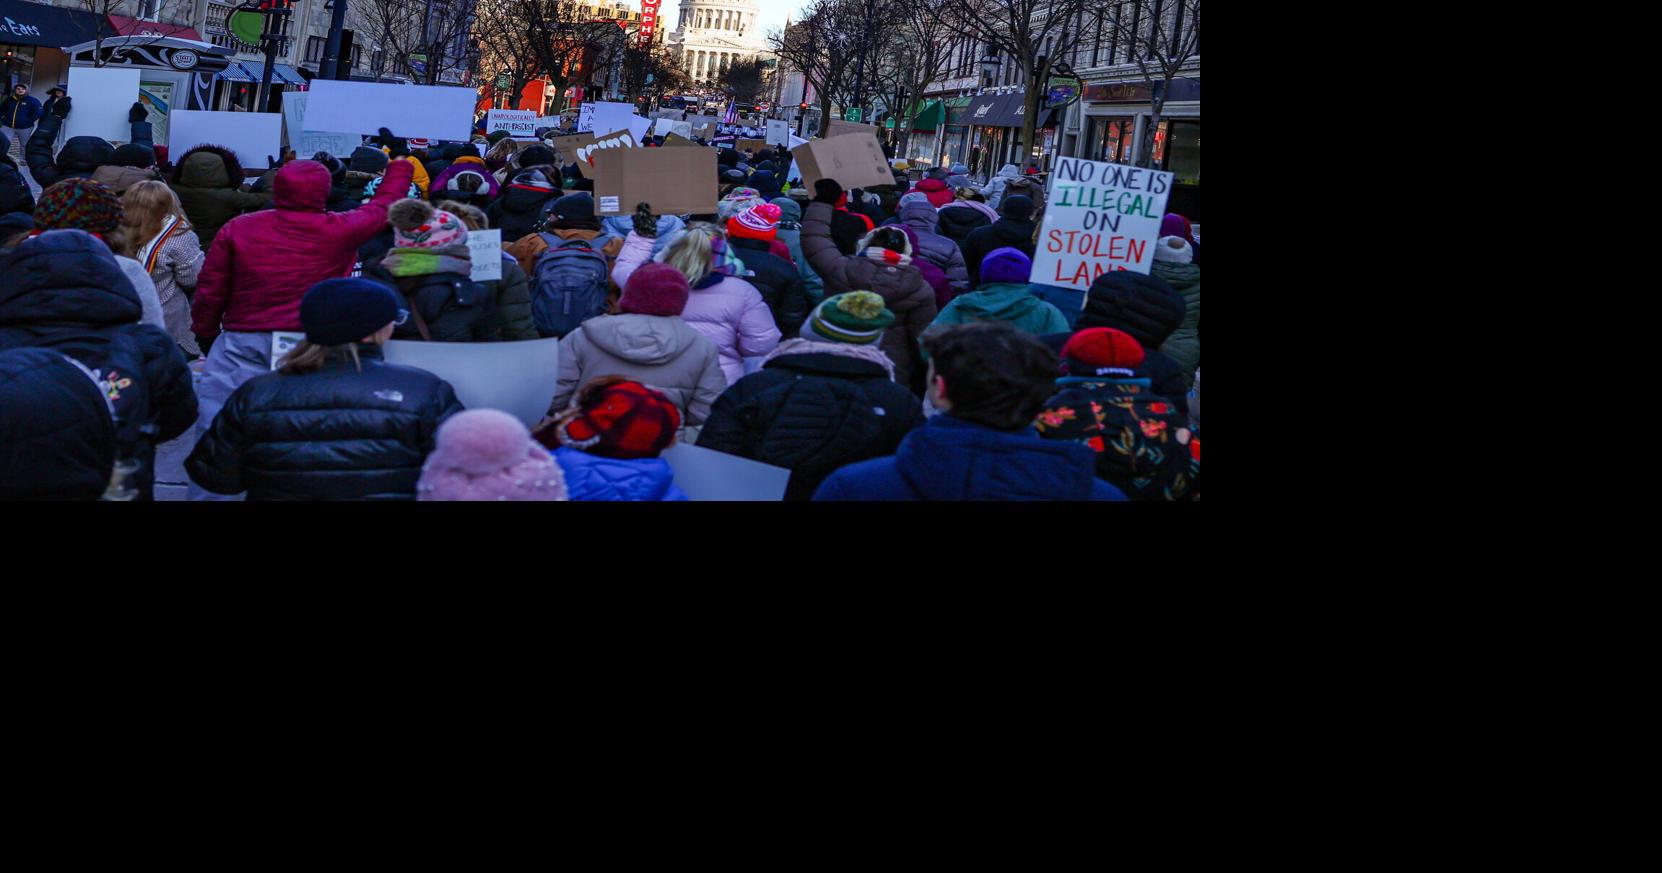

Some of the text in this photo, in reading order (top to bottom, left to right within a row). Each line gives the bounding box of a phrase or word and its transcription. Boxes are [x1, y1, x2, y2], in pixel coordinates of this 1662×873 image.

[4, 16, 40, 36] Eats
[494, 122, 535, 131] ANTI-FASCIST
[1057, 159, 1167, 194] NO ONE IS
[1054, 185, 1159, 219] ILLEGAL
[1083, 210, 1121, 232] ON
[1047, 229, 1146, 264] STOLEN
[1055, 259, 1128, 287] LAN
